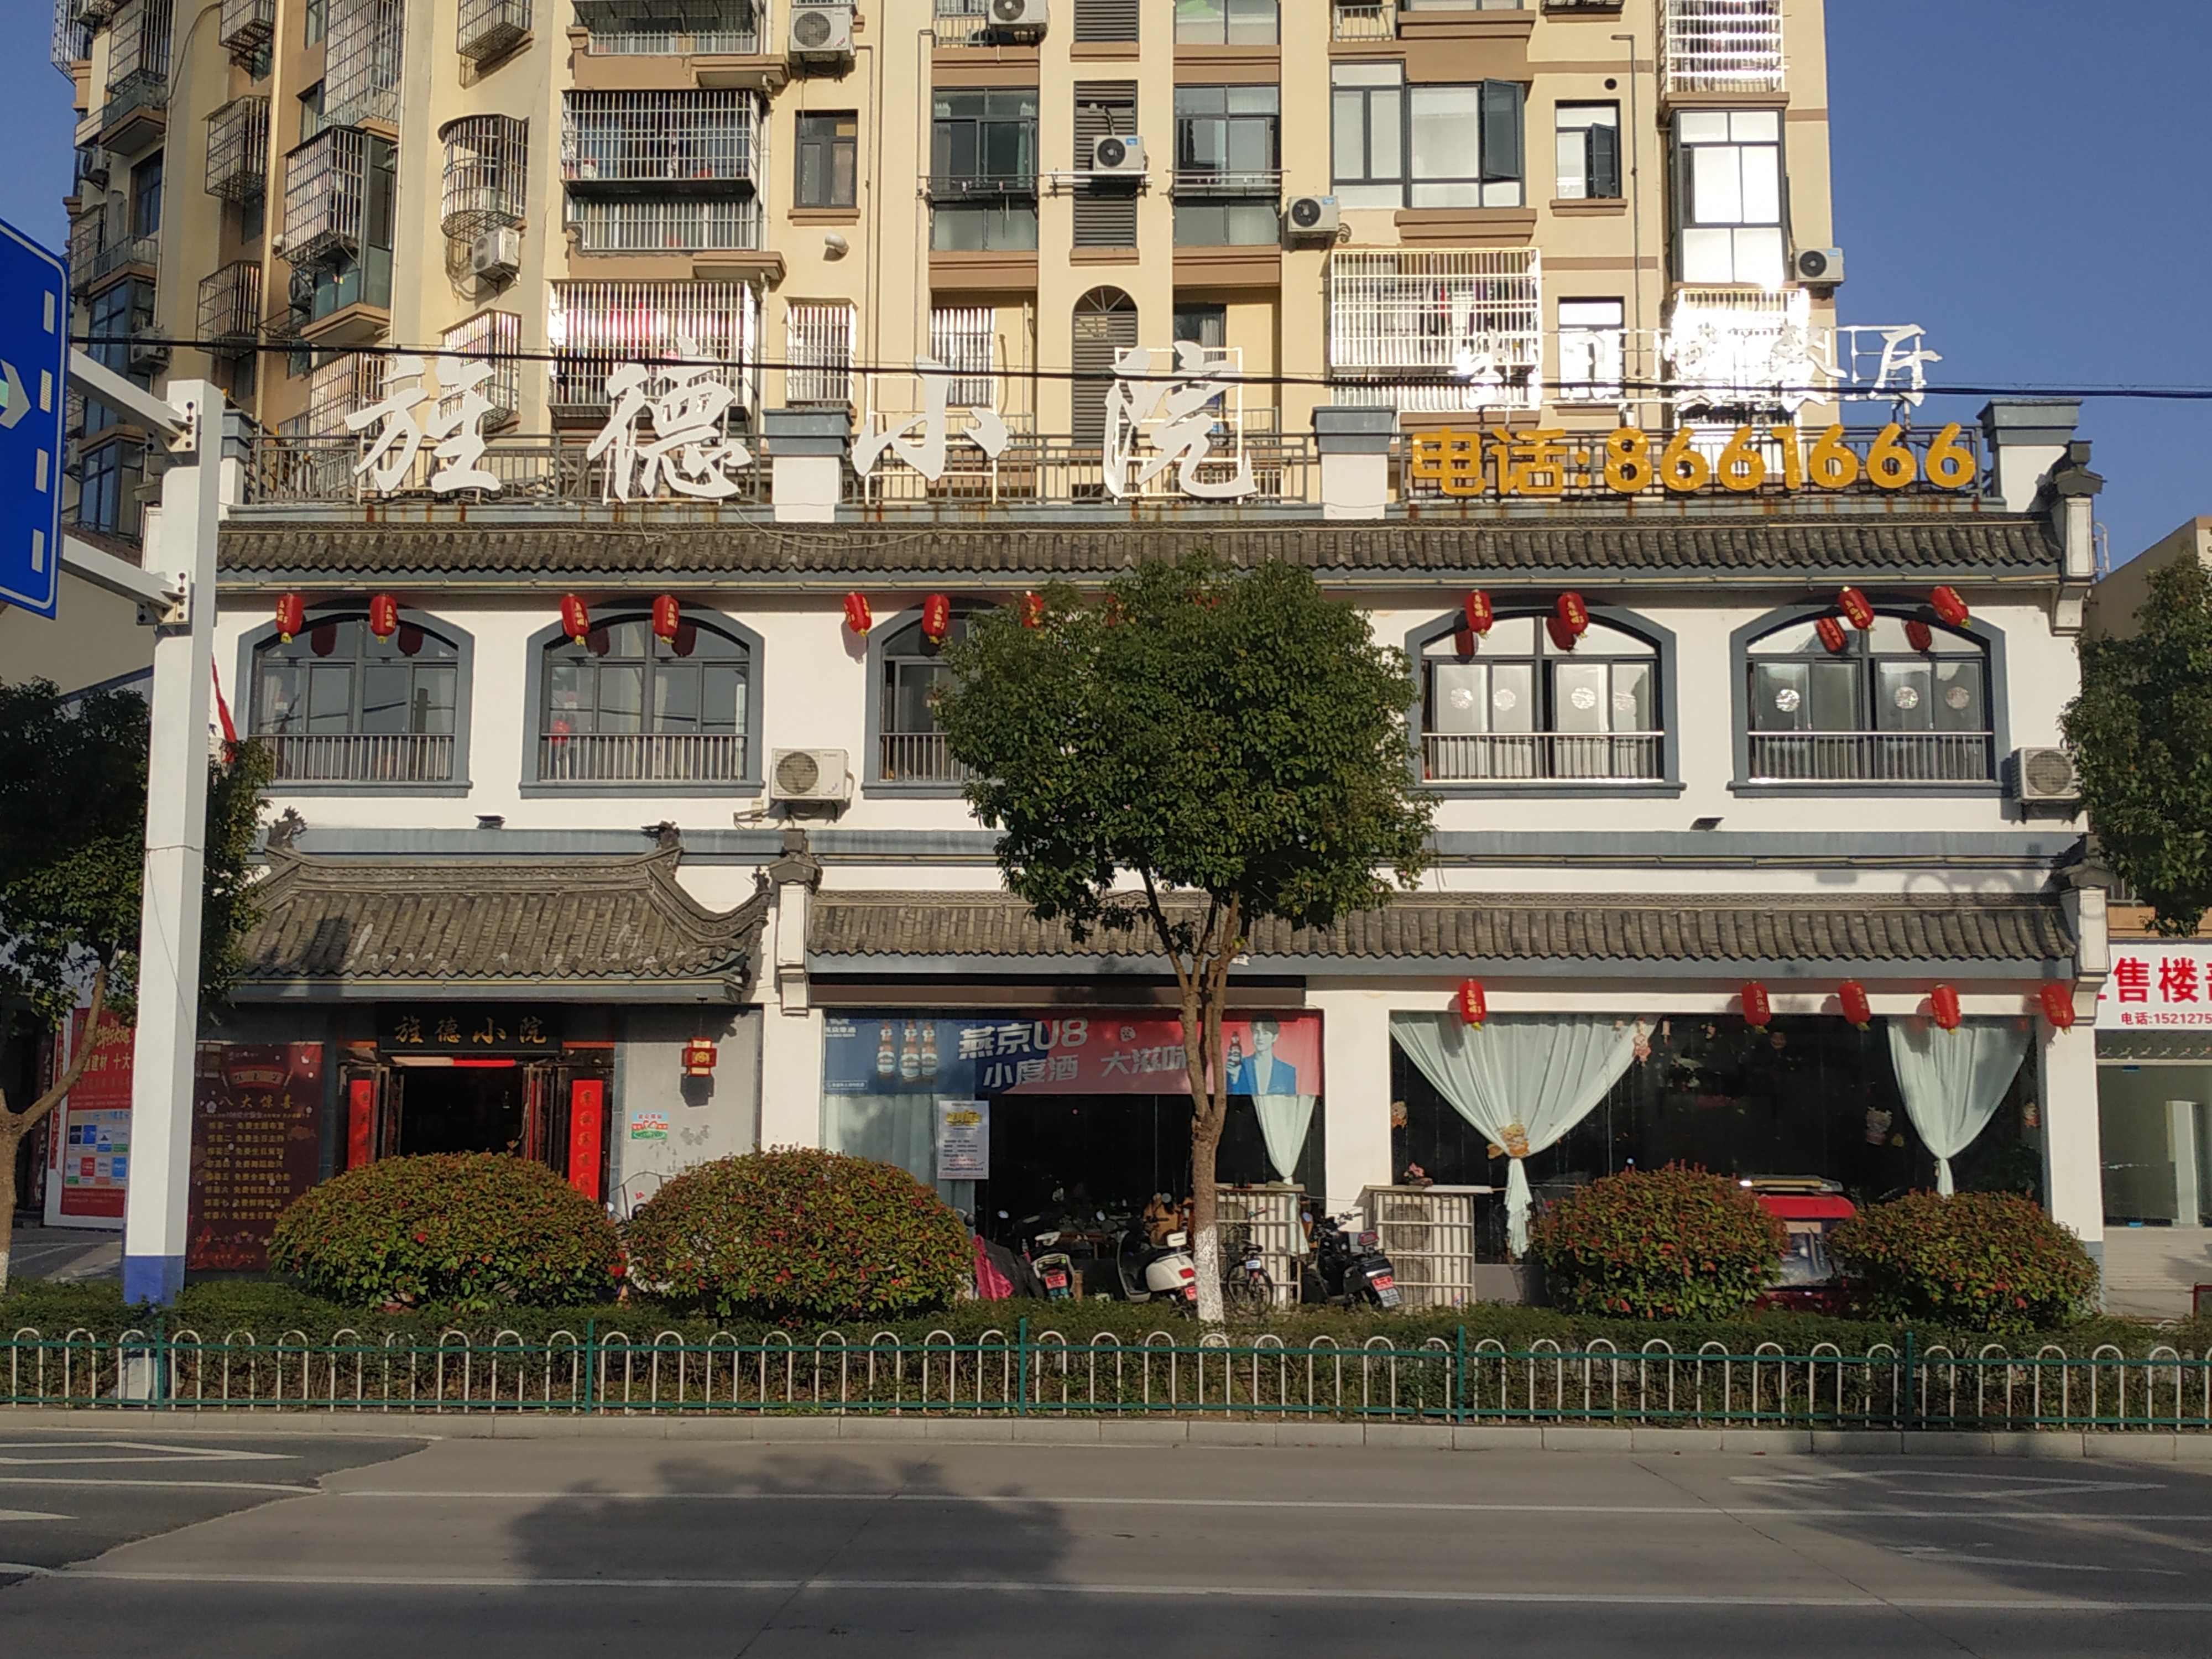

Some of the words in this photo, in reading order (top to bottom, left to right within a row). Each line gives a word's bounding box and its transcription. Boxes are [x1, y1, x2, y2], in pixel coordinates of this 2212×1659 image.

[1411, 422, 1976, 496] 电话:8661666
[2098, 957, 2212, 1003] 售楼
[394, 1015, 547, 1044] 旌德小院
[958, 1017, 1089, 1060] 燕京U8
[983, 1055, 1078, 1088] 小度酒
